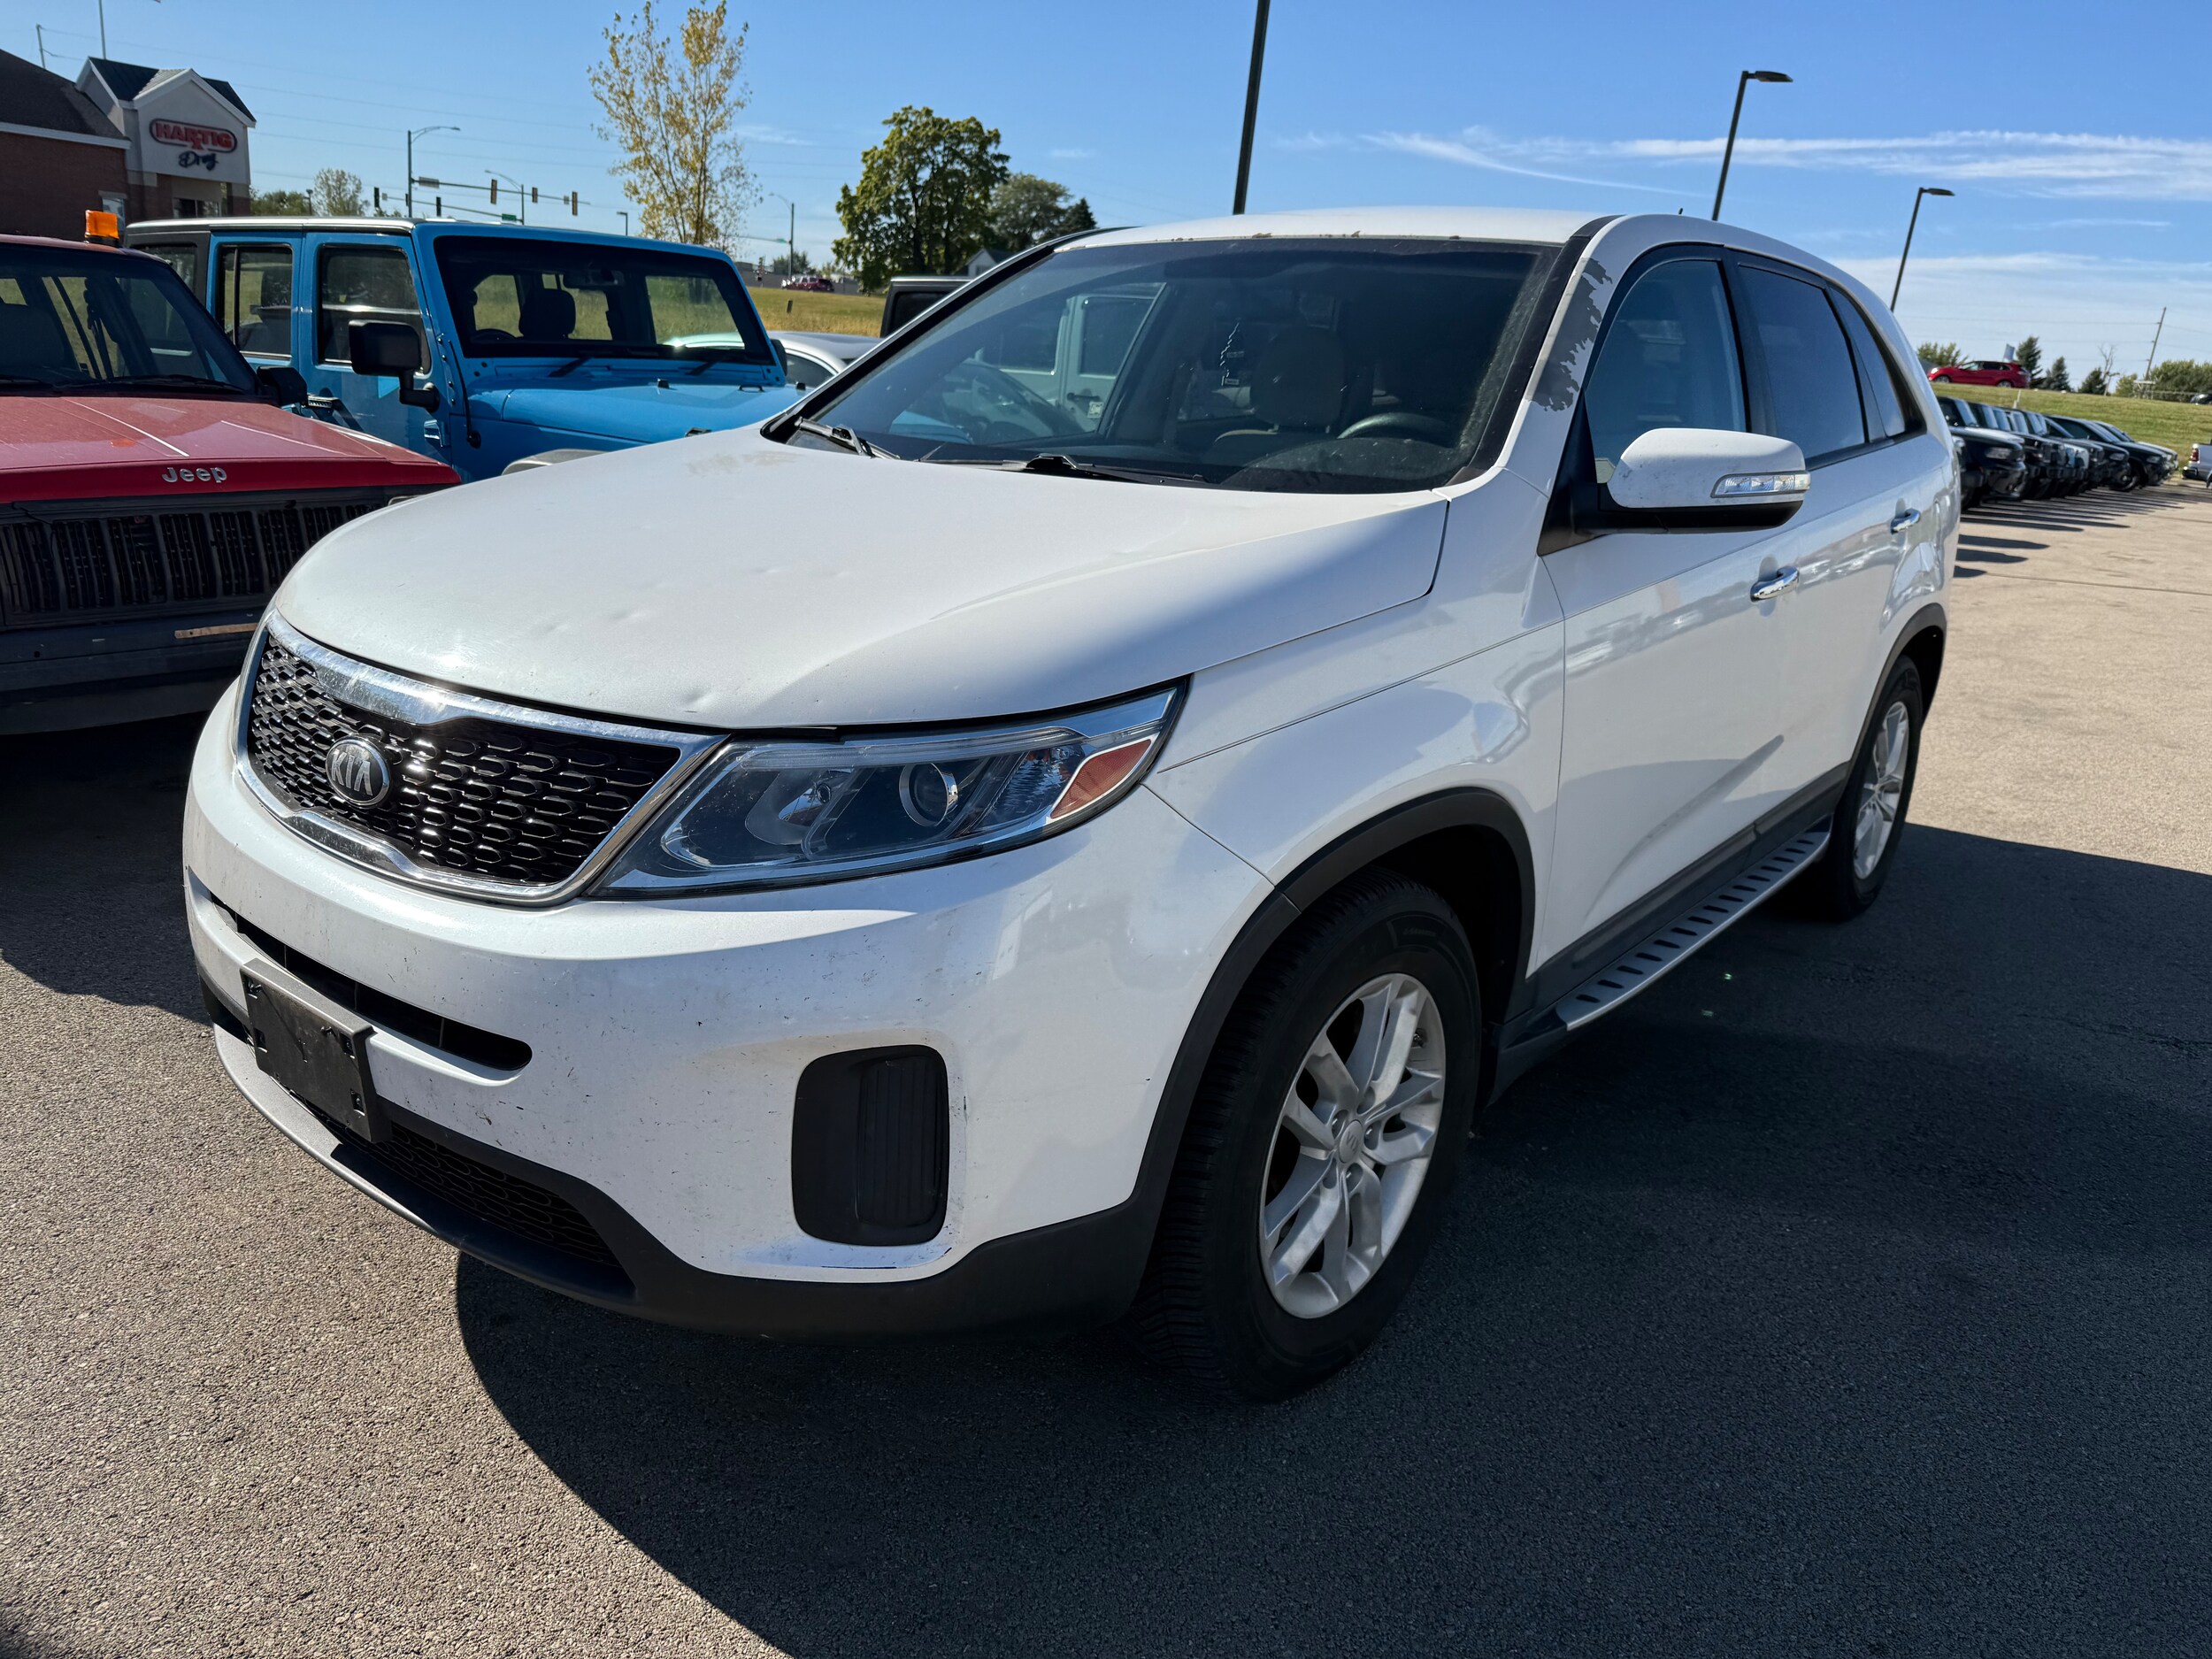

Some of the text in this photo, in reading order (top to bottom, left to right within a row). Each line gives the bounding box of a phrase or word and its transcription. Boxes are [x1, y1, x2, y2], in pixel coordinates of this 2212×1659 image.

[155, 122, 233, 150] HARTIG
[178, 150, 219, 172] Drug
[161, 466, 227, 483] Jeep
[331, 749, 373, 796] KIA
